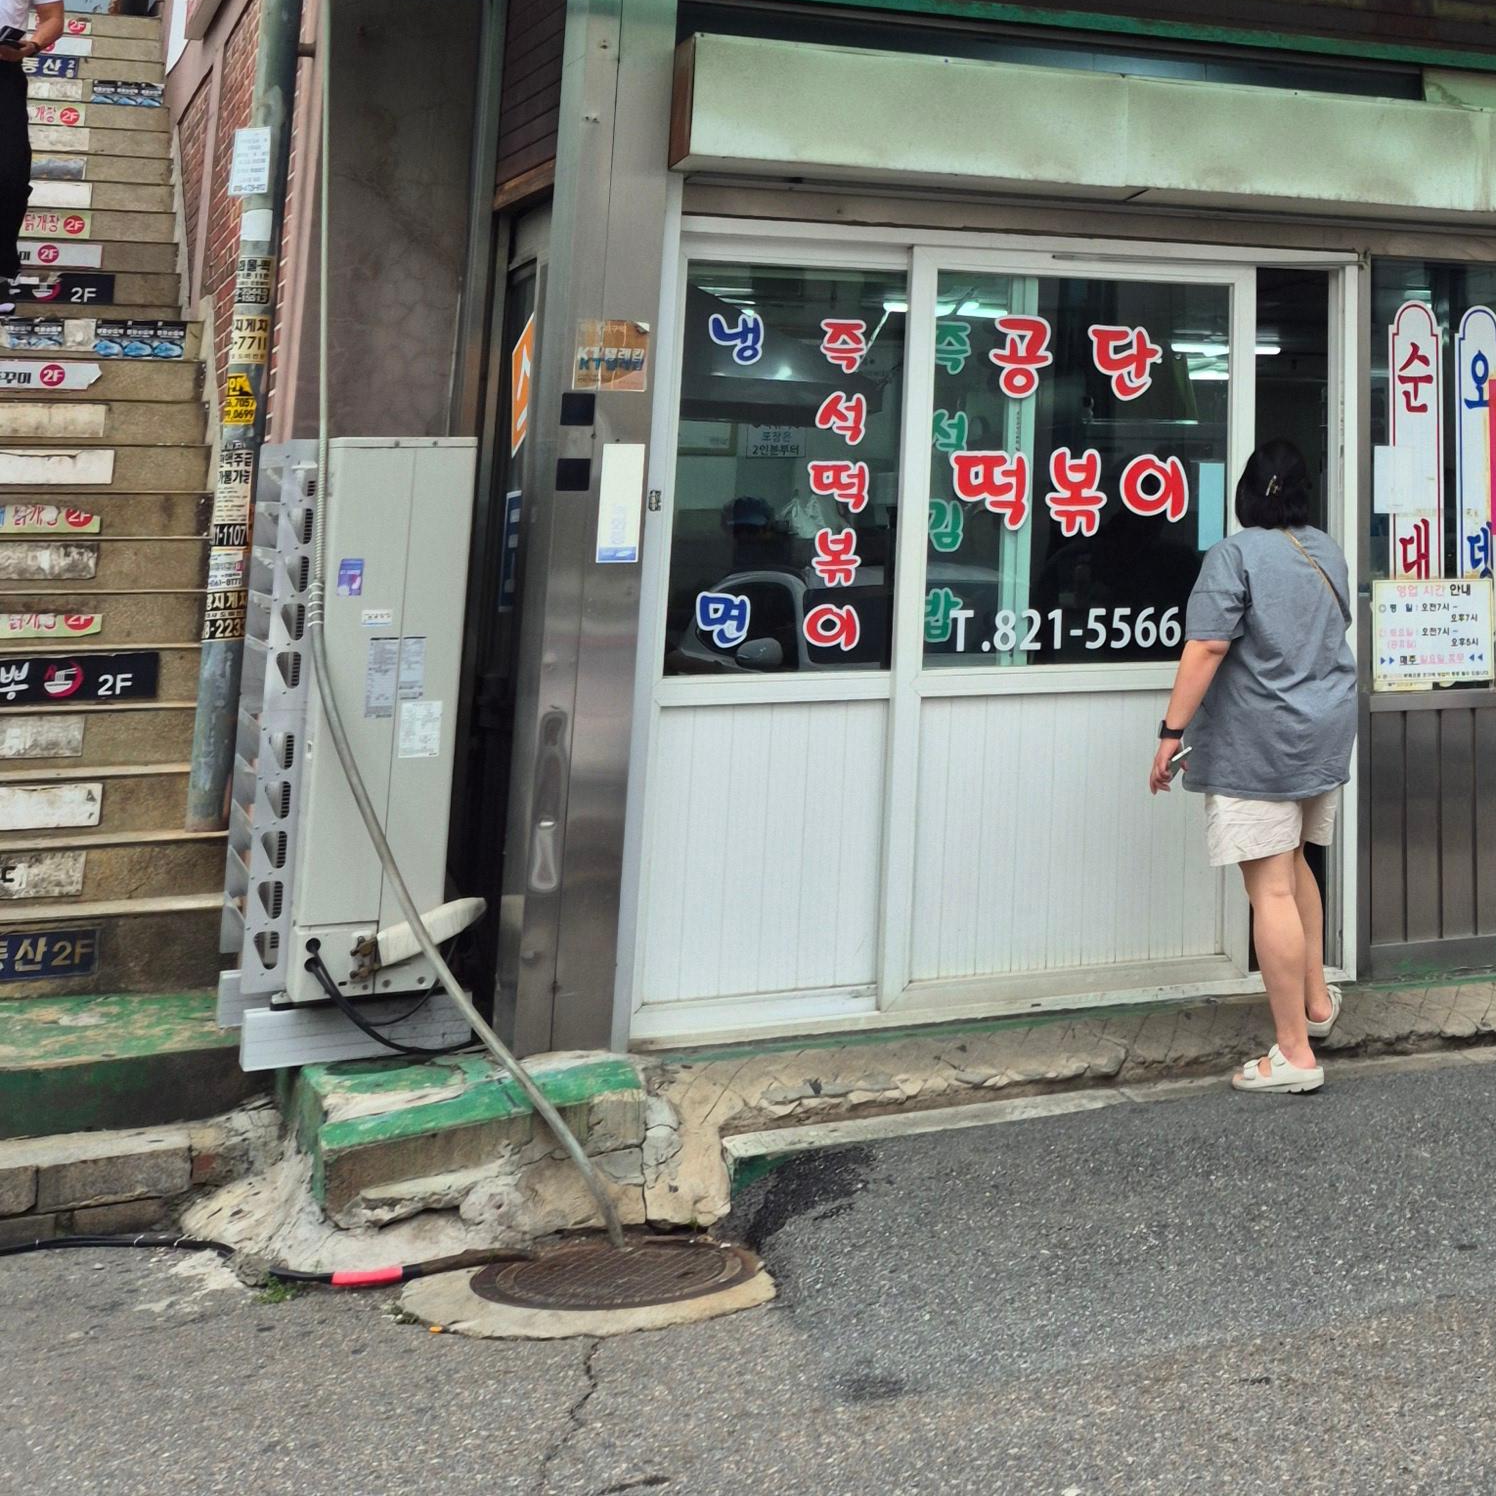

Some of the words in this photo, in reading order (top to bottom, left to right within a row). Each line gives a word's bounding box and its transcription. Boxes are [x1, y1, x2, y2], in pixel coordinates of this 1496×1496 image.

[24, 213, 60, 233] 닭개장
[63, 218, 84, 231] 2F
[39, 248, 58, 261] 2F
[70, 287, 97, 303] 2F
[990, 315, 1163, 401] 공단
[42, 369, 64, 382] 2F
[803, 319, 869, 651] 즉석떡볶이
[950, 447, 1189, 538] 떡볶이
[1449, 584, 1471, 596] 안내
[1421, 603, 1450, 612] 오전7시
[1450, 613, 1478, 622] 오후7시
[1450, 637, 1479, 647] 오후5시
[97, 673, 133, 696] 2F
